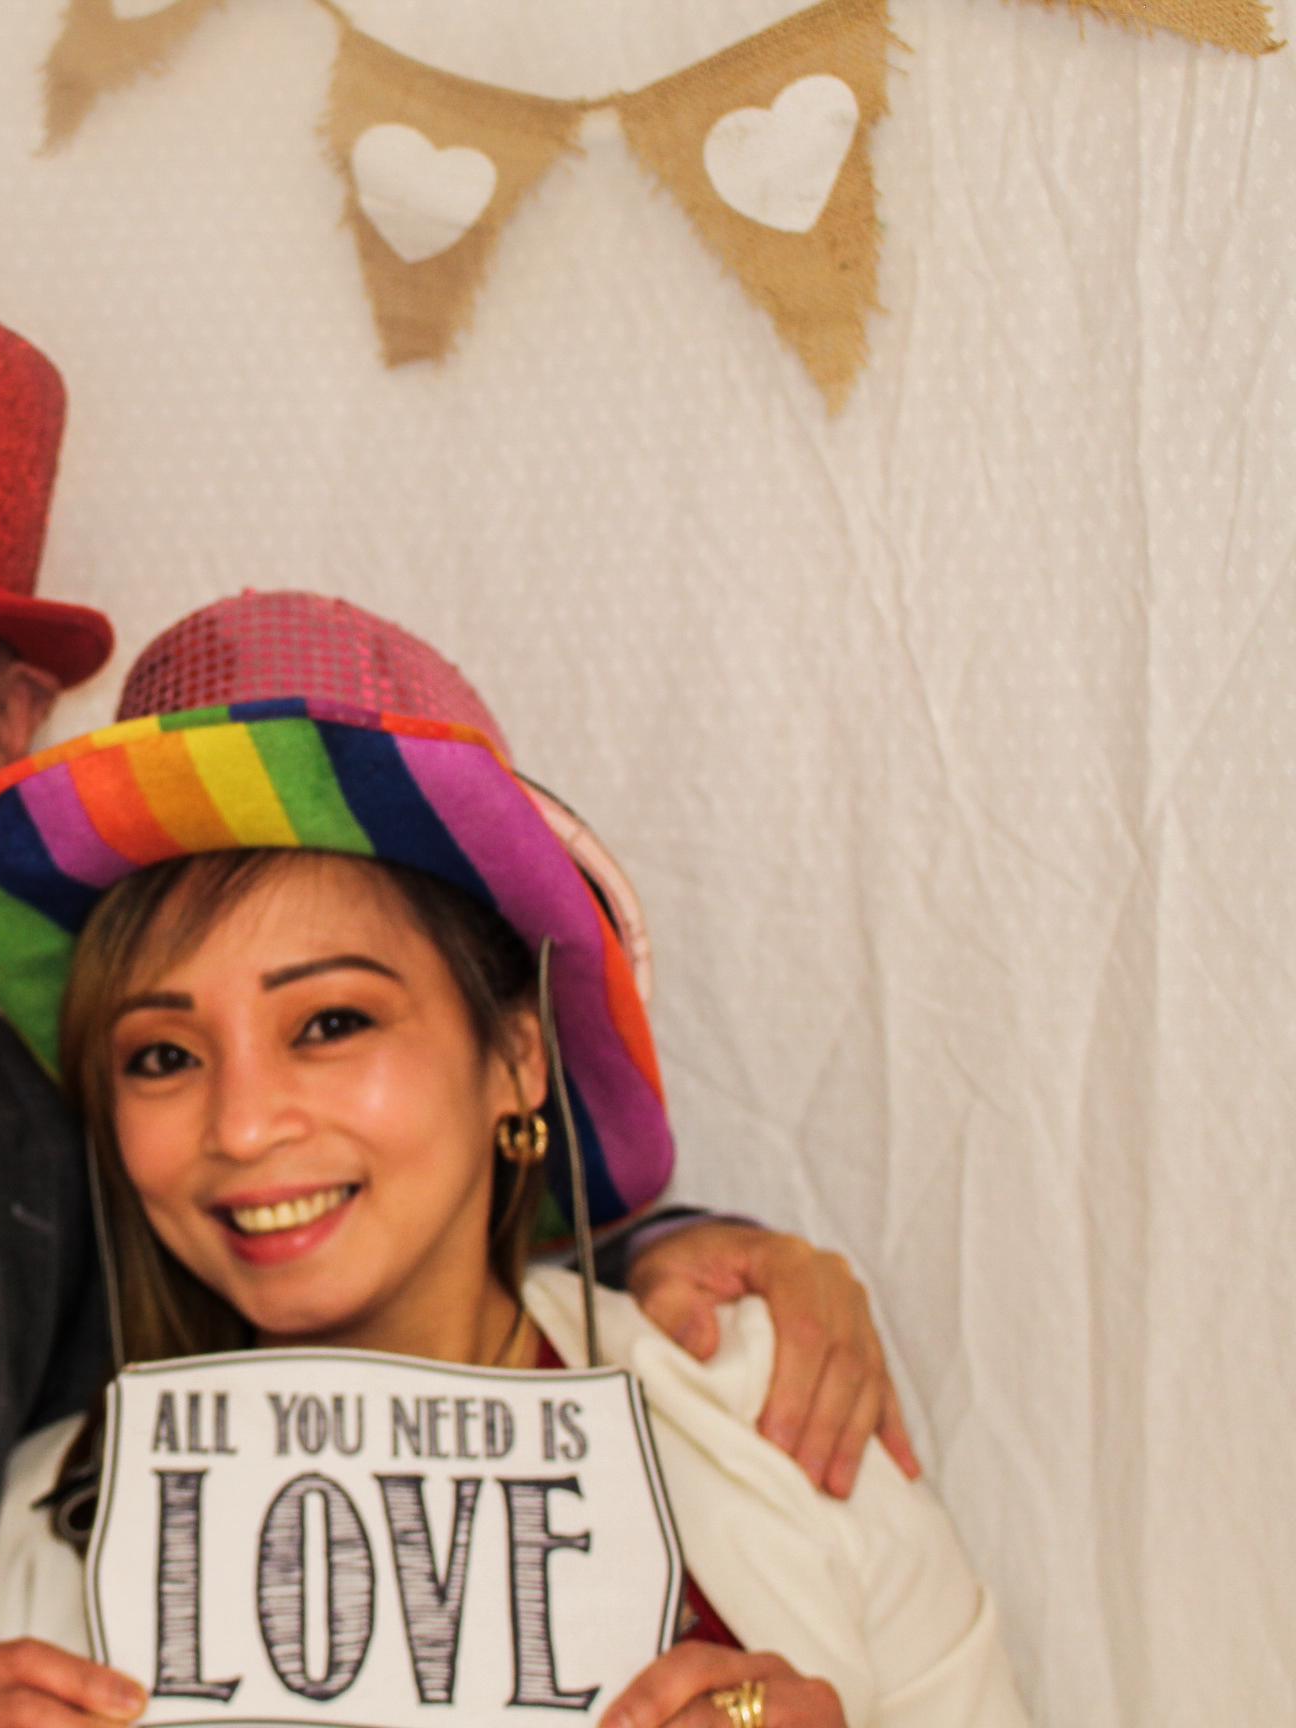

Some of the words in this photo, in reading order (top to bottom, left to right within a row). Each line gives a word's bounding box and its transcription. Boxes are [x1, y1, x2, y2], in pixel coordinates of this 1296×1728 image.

[151, 1390, 238, 1455] ALL
[266, 1392, 365, 1456] YOU
[390, 1393, 515, 1460] NEED
[542, 1399, 588, 1461] IS
[149, 1468, 601, 1711] LOVE
